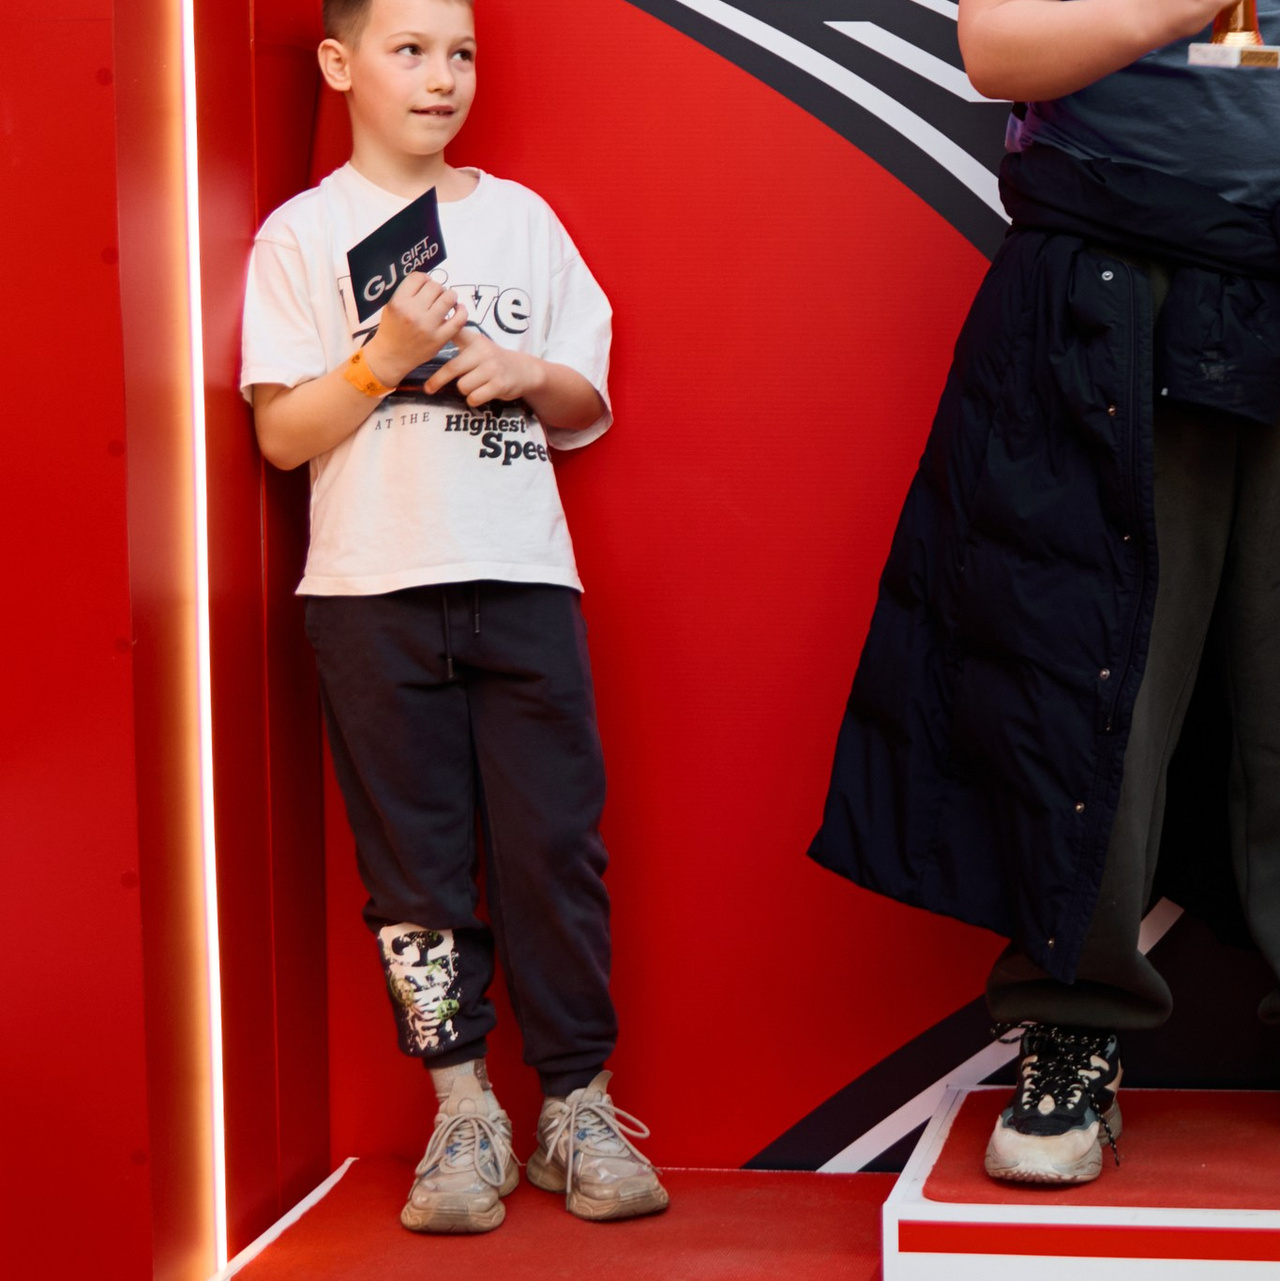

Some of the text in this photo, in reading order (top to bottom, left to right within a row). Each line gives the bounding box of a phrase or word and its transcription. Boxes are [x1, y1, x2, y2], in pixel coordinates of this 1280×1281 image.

[401, 235, 430, 265] GIFT
[403, 242, 439, 276] CARD
[363, 262, 398, 302] GJ
[375, 411, 526, 436] AT THE Highest
[479, 431, 552, 466] Spee
